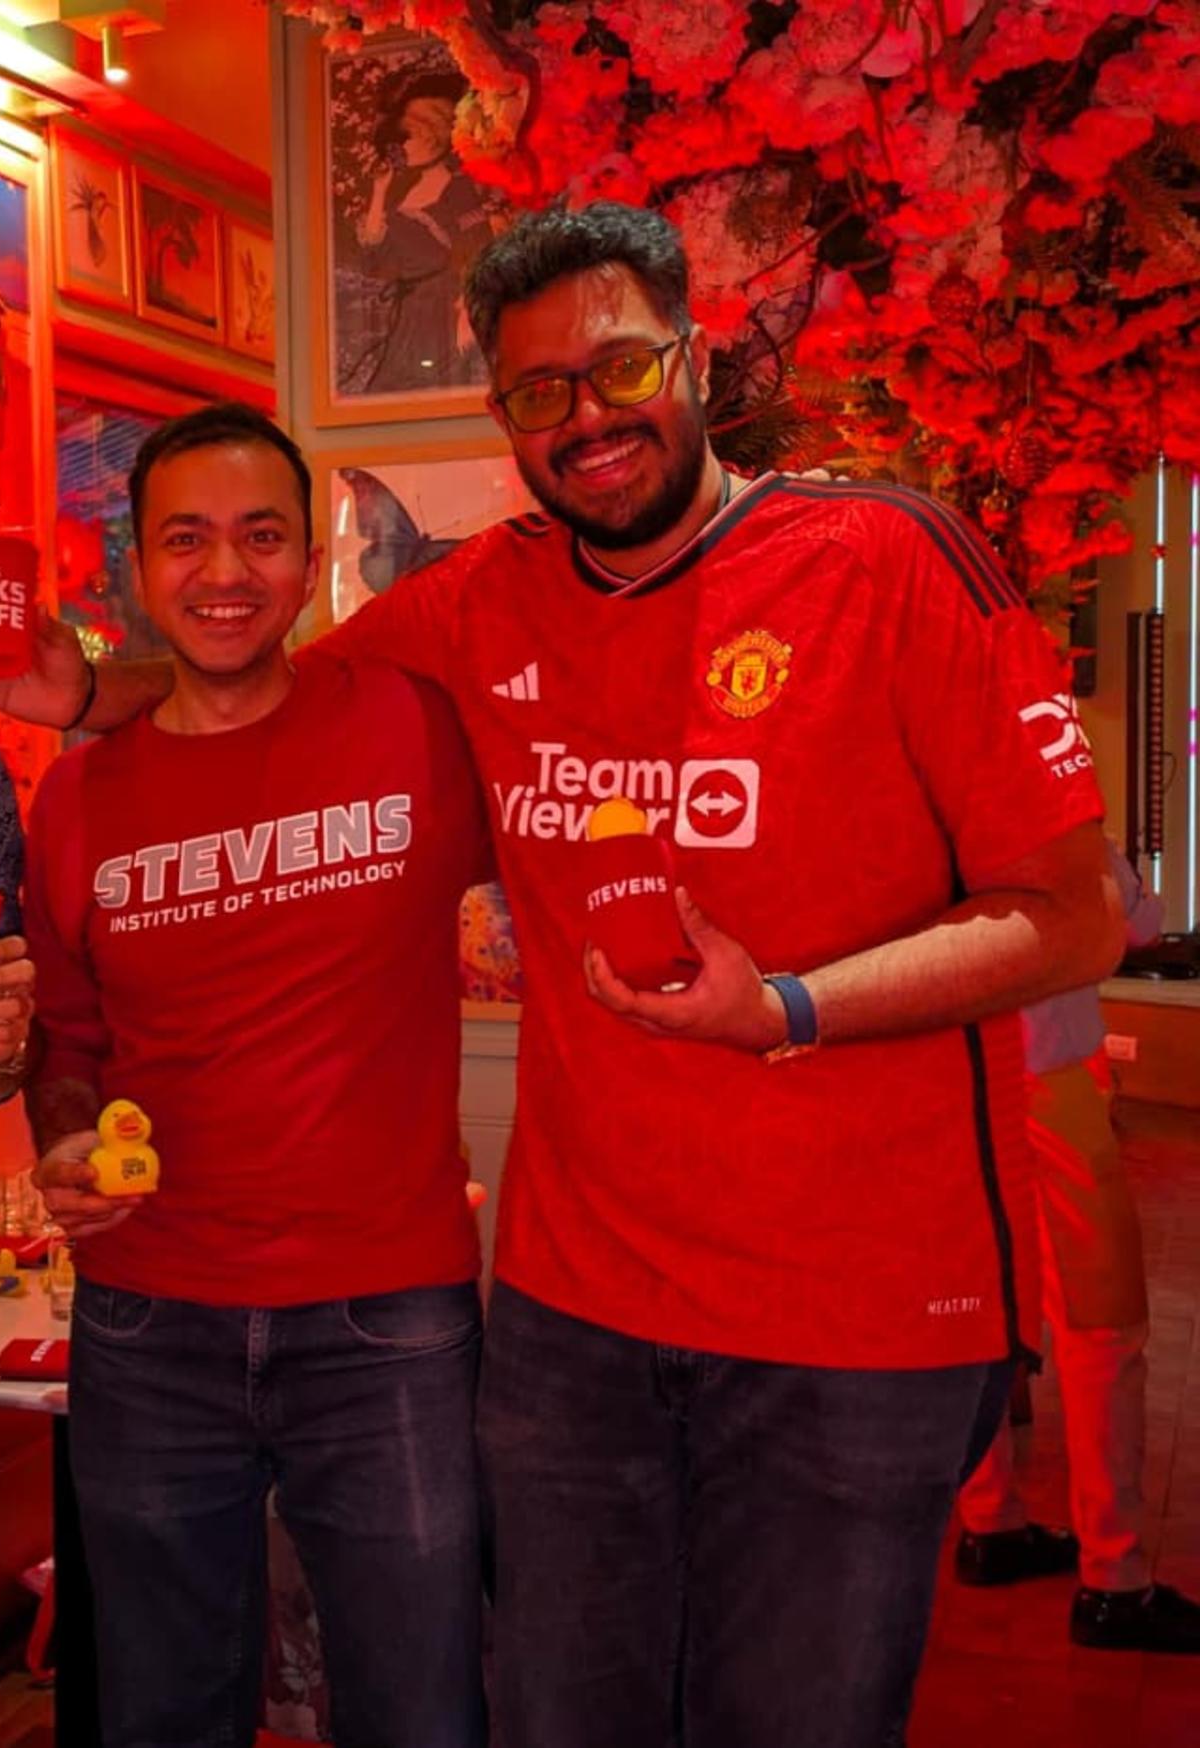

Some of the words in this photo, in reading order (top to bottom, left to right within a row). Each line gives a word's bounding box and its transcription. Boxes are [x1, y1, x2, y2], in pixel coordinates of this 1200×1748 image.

[530, 741, 674, 800] Team
[492, 781, 671, 843] Viewr
[93, 794, 413, 909] STEVENS
[109, 900, 218, 934] INSTITUTE
[223, 892, 254, 914] OF
[259, 858, 406, 905] TECHNOLOGY
[586, 876, 668, 912] STEVENS
